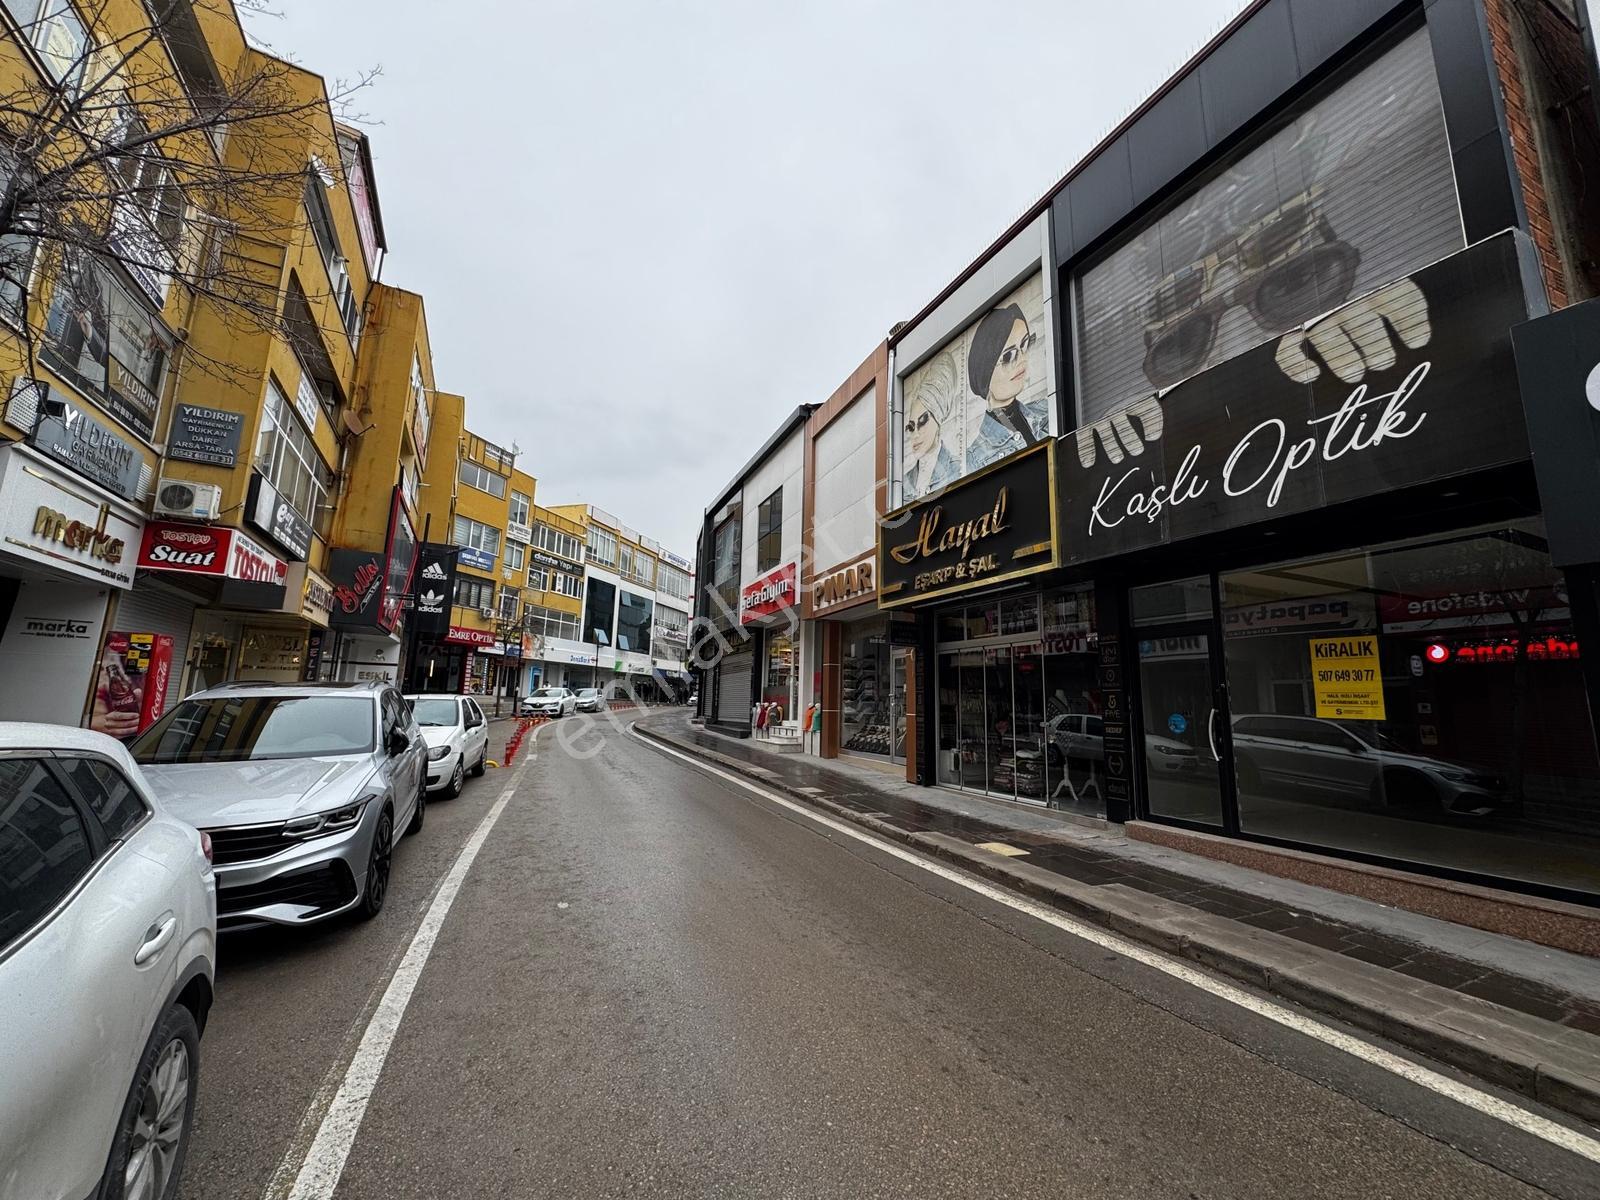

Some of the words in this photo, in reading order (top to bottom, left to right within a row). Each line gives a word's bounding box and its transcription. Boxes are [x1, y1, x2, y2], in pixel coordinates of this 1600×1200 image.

[183, 406, 239, 423] YILDIRIM
[64, 403, 133, 471] YILDIRIM
[1088, 444, 1209, 535] Kaşlı
[1222, 361, 1431, 507] Optik
[33, 503, 124, 565] marka
[890, 485, 1012, 564] Hayal
[149, 544, 216, 566] Suat
[955, 560, 967, 580] &
[969, 553, 1000, 579] ŞAL
[422, 572, 447, 580] adidas
[813, 562, 873, 606] PINAR
[26, 620, 88, 634] marka
[448, 628, 470, 640] EMRE
[1318, 670, 1333, 682] 507
[1335, 669, 1350, 682] 649
[1352, 670, 1362, 681] 30
[1364, 669, 1374, 681] 77
